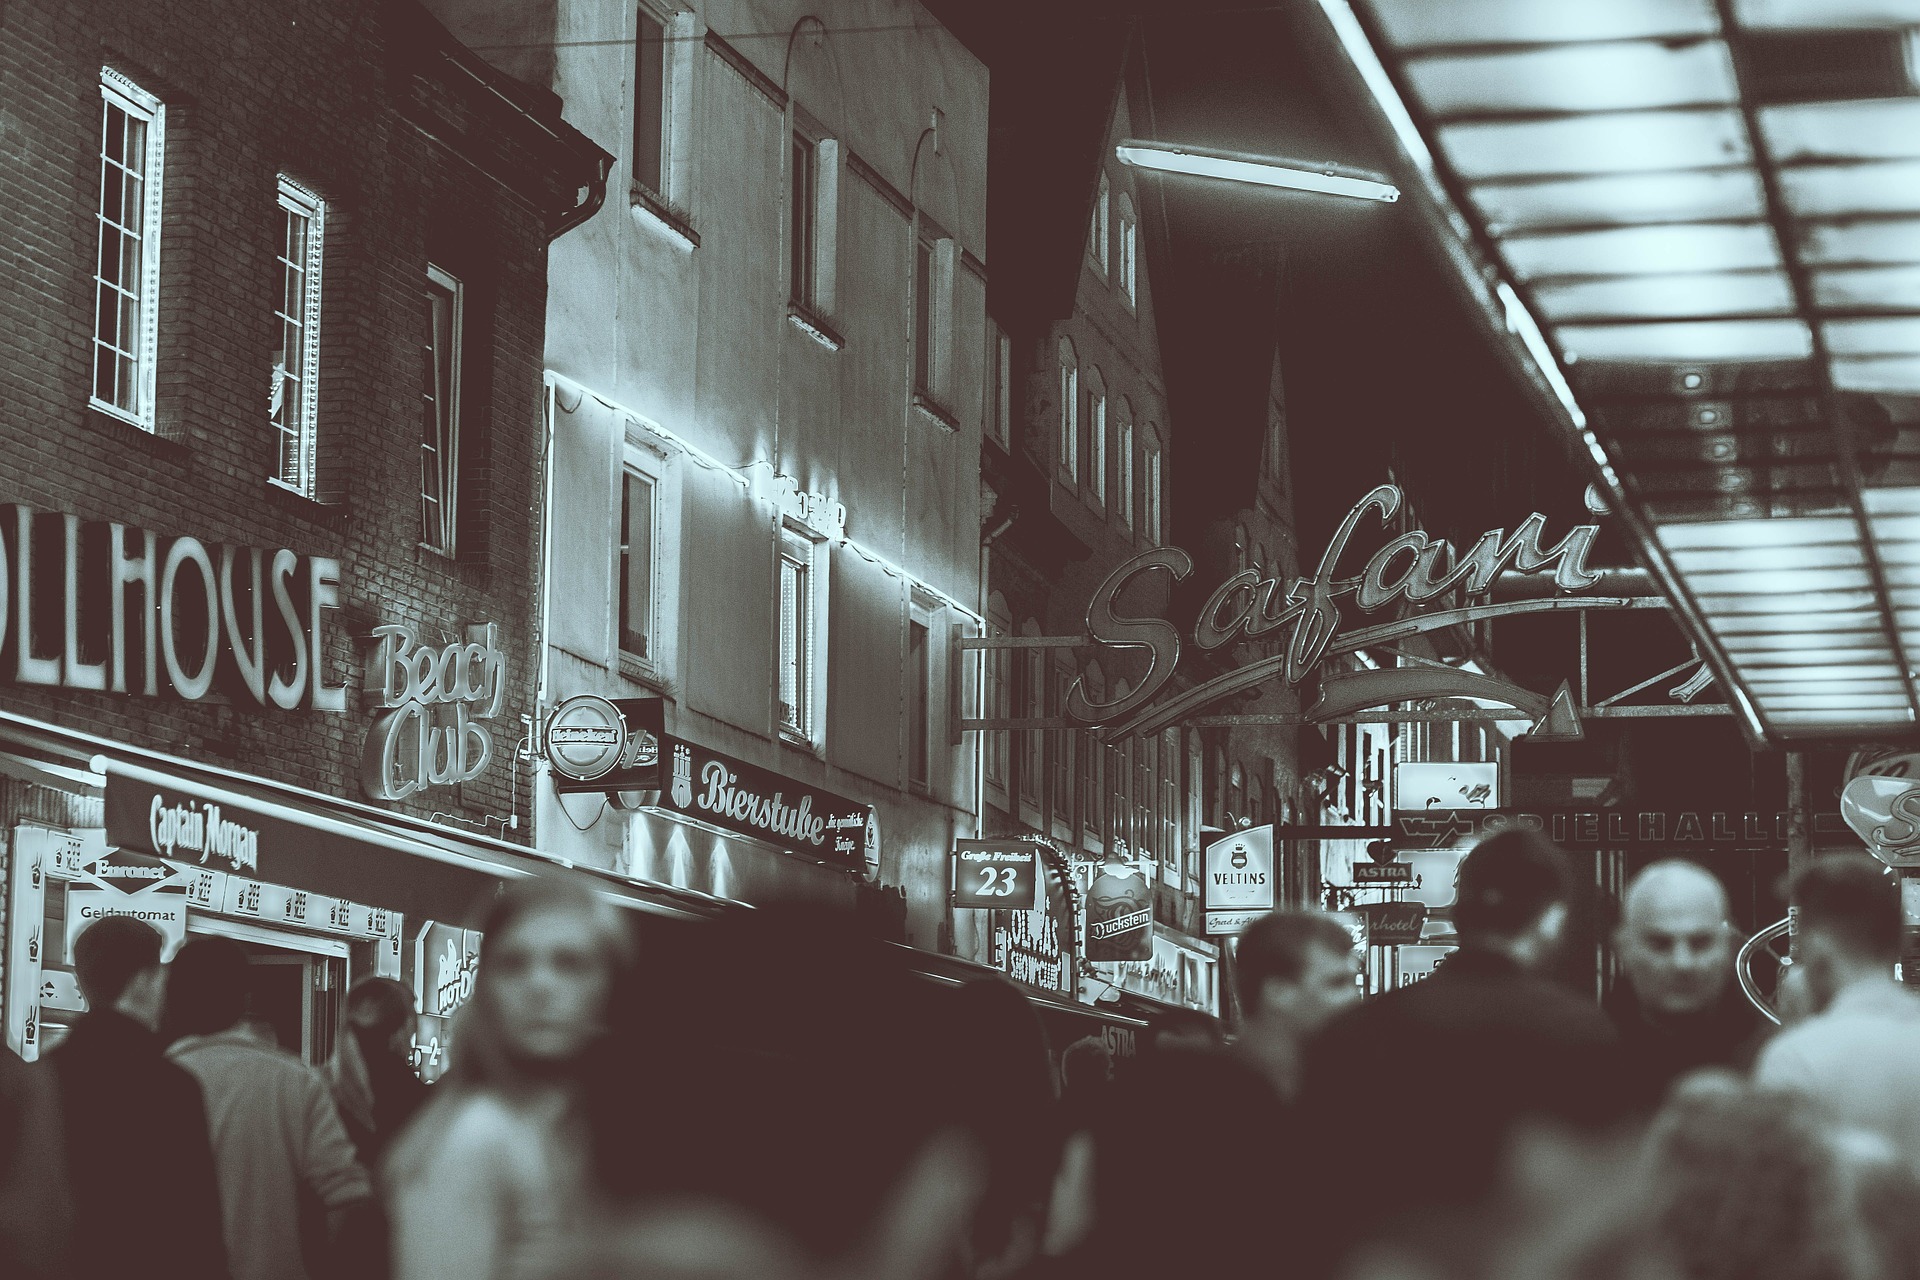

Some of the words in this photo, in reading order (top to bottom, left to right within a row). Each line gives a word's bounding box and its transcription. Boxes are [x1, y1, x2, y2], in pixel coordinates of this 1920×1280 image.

[0, 504, 349, 712] LLHOUSE
[1066, 483, 1613, 723] Safari
[372, 622, 506, 719] Beach
[382, 700, 493, 800] Club
[698, 760, 825, 846] Bierstube
[150, 794, 204, 858] Captain
[200, 803, 259, 874] Morgan
[98, 860, 167, 880] Euronet
[992, 851, 1033, 863] Freiheit
[1357, 866, 1408, 878] ASTRA
[975, 866, 1018, 897] 23
[1213, 872, 1267, 886] VELTINS
[1091, 912, 1150, 940] Duckstein
[438, 984, 461, 1011] HOT
[1102, 1024, 1137, 1058] ASTRA
